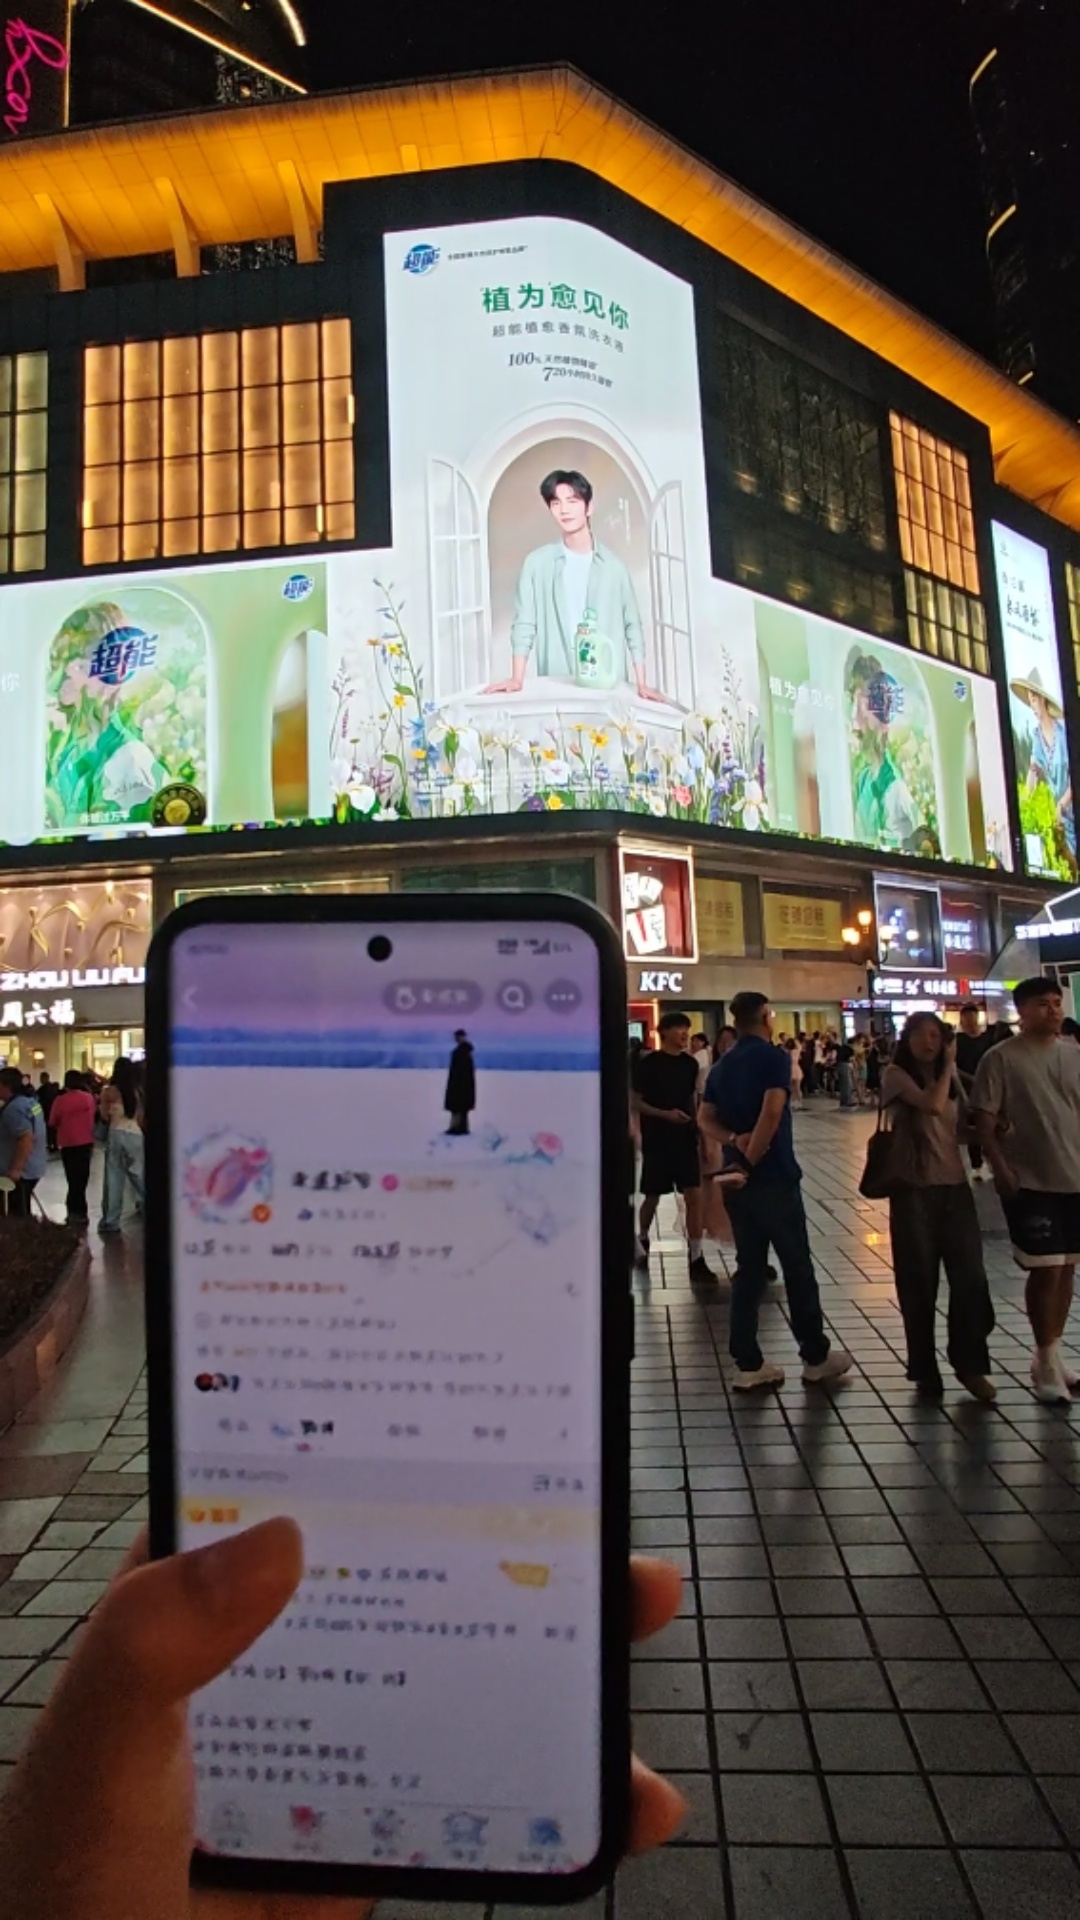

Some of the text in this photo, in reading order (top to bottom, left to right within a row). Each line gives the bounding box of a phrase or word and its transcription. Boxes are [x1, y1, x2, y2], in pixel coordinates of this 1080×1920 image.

[482, 282, 630, 330] 植为愈见你
[88, 634, 159, 678] 超能
[0, 969, 70, 991] ZHOU
[640, 970, 683, 992] KFC
[0, 998, 75, 1028] 周六福
